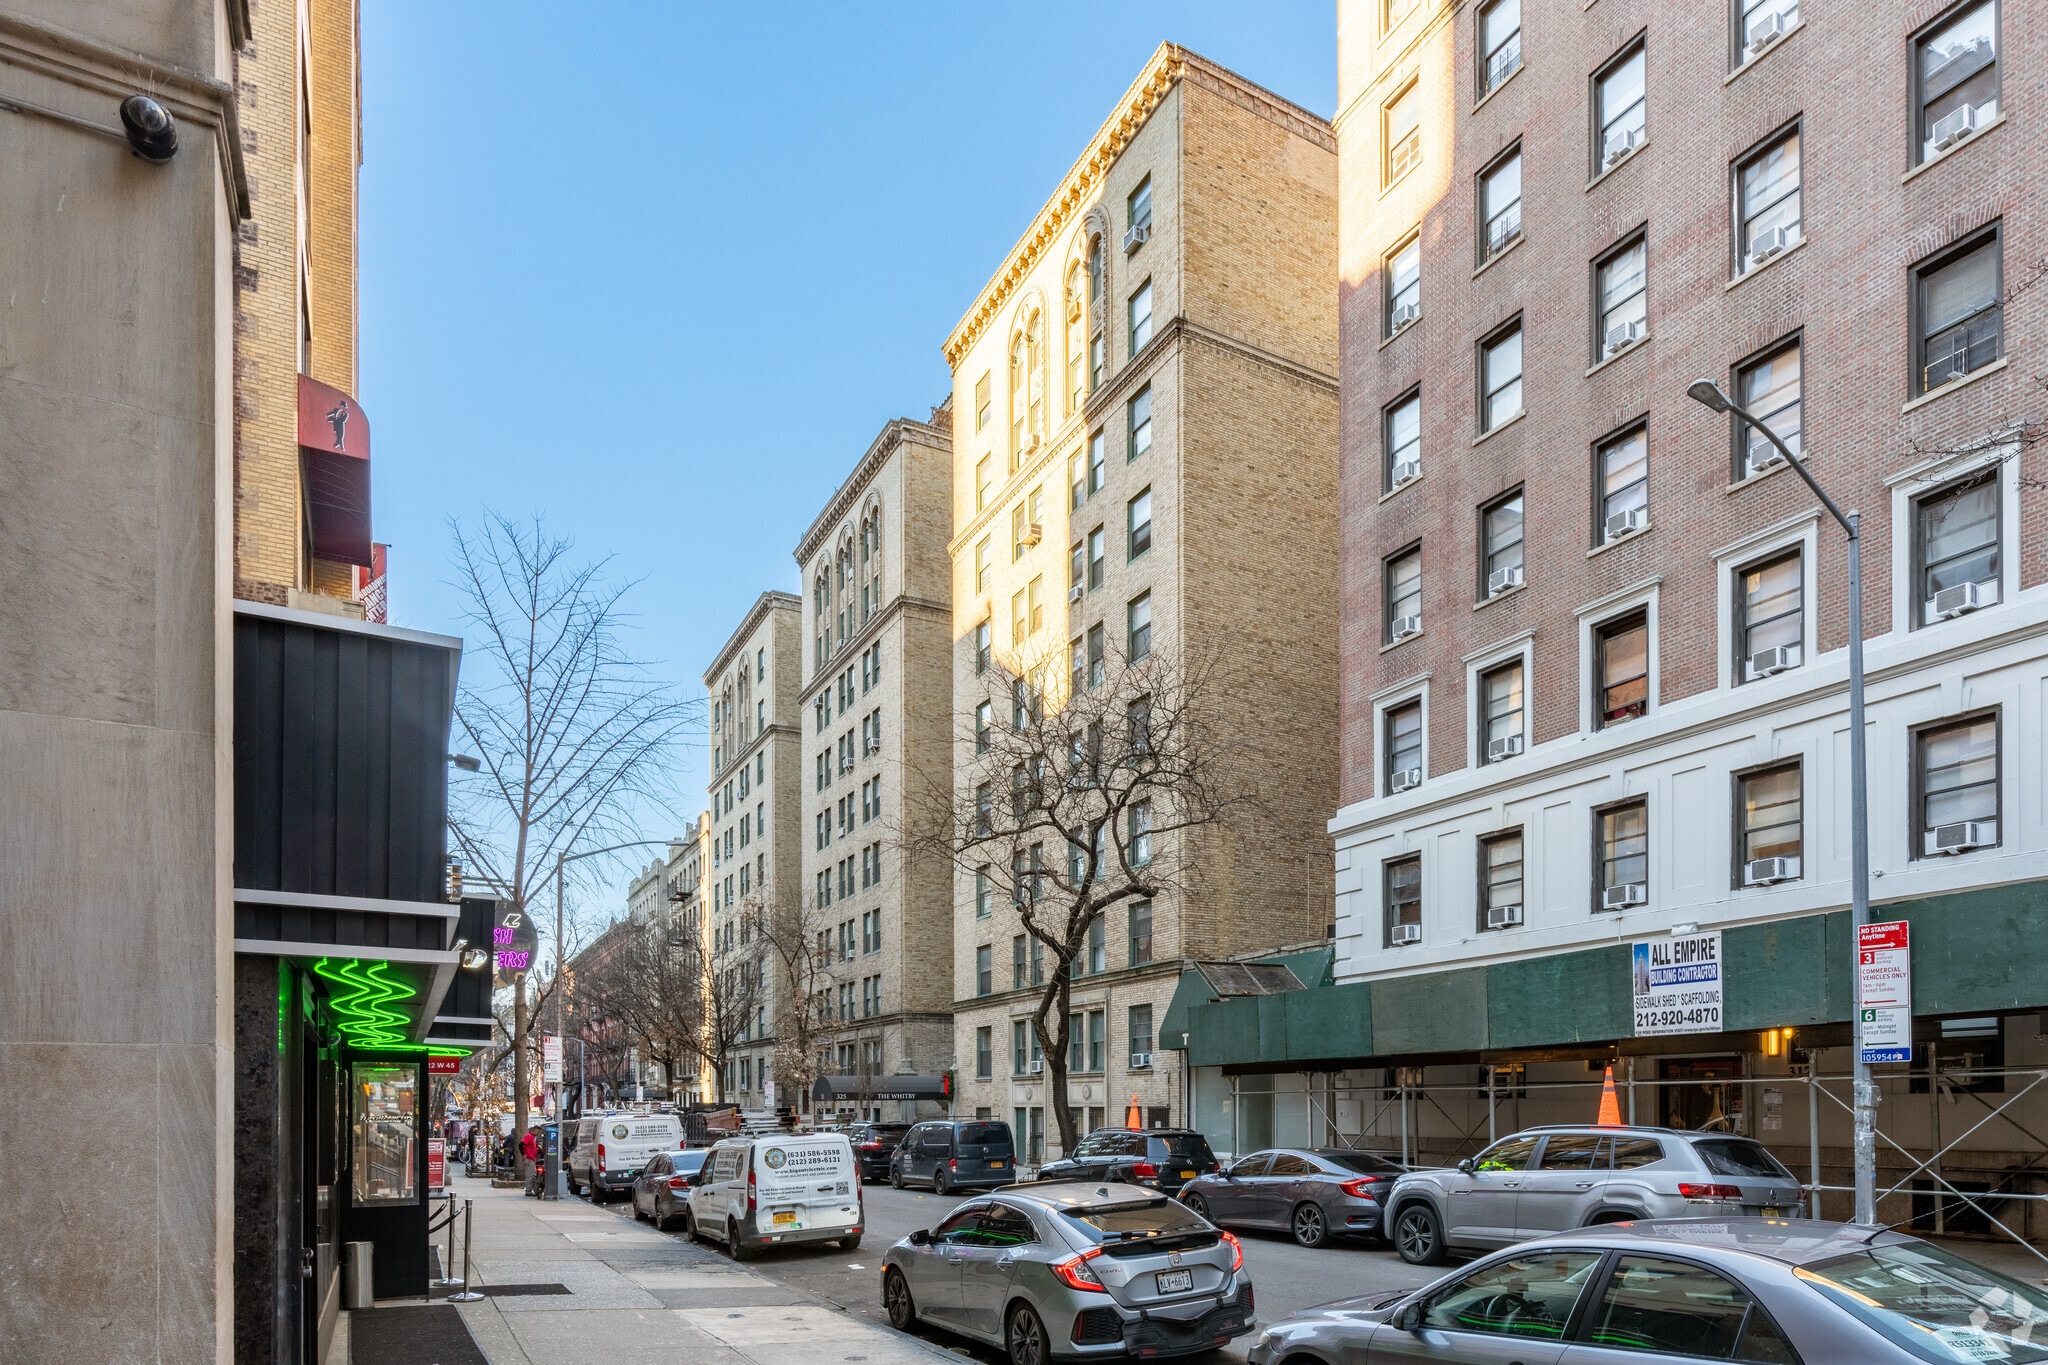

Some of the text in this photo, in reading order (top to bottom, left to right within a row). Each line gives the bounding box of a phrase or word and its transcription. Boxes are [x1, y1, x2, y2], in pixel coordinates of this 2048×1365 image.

[1652, 938, 1715, 966] ALL EMPIRE
[1864, 953, 1872, 964] 3
[1651, 964, 1717, 984] BUILDING CONTRACTOR
[1636, 991, 1719, 1009] SIDEWALK SHED SCAFFOLDING
[1637, 1008, 1718, 1027] 212-920-4870
[1865, 1010, 1873, 1021] 6
[1863, 1054, 1891, 1062] 105954
